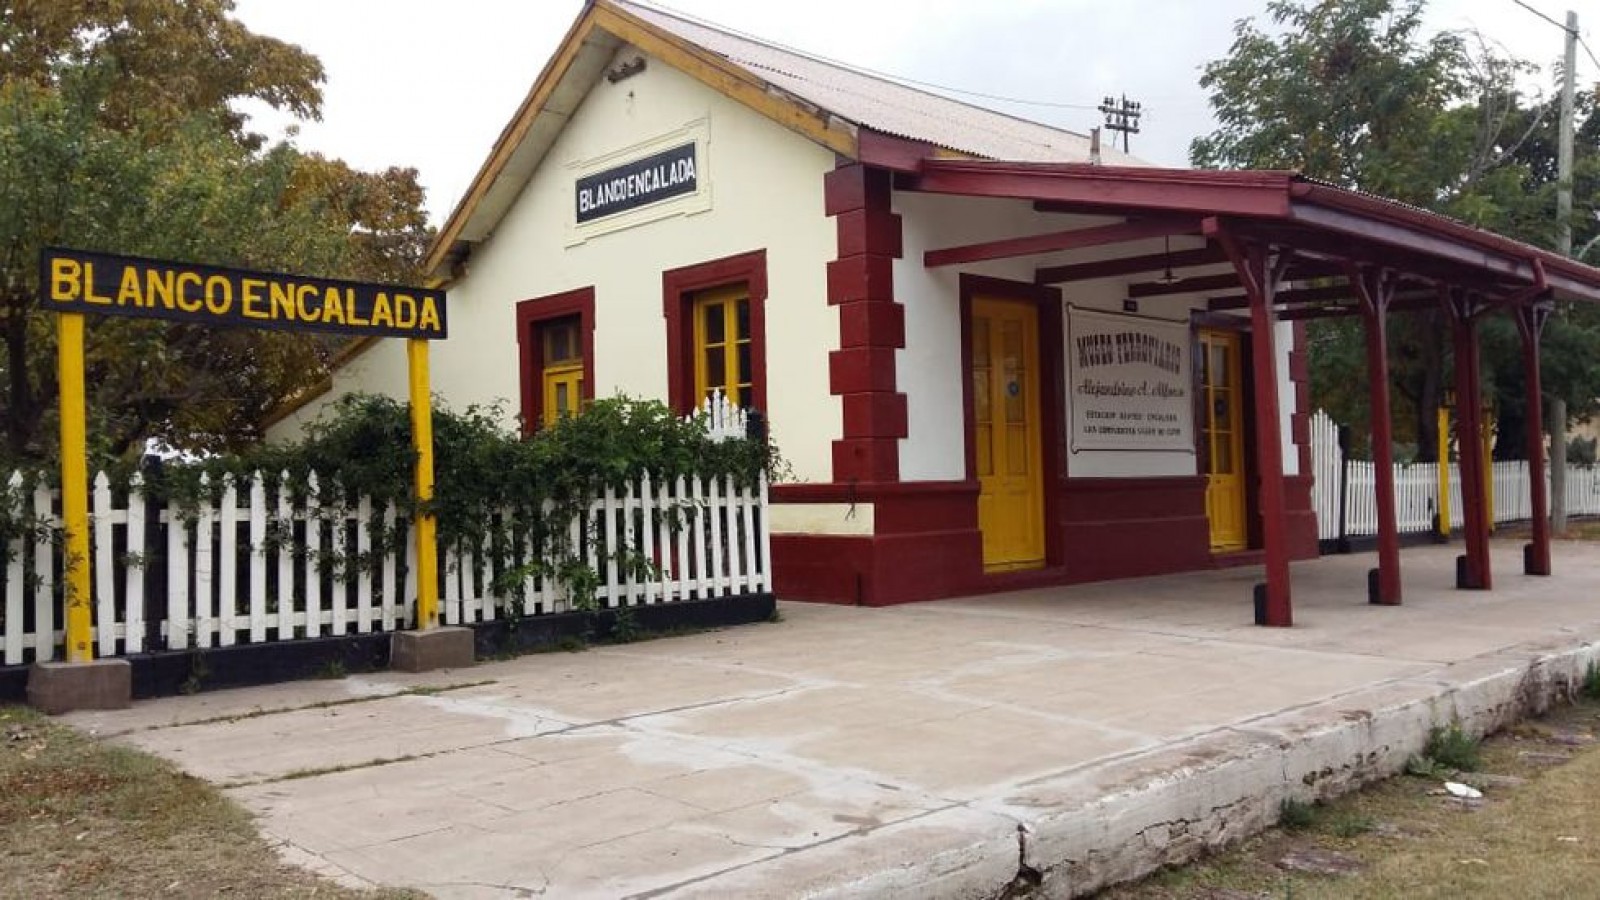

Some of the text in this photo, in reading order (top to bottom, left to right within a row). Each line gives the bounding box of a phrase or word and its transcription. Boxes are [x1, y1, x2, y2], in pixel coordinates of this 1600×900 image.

[580, 157, 696, 212] BLANCO ENCALADA
[51, 258, 441, 331] BLANCO ENCALADA
[1077, 332, 1180, 375] MUSEO FERROVIARIO
